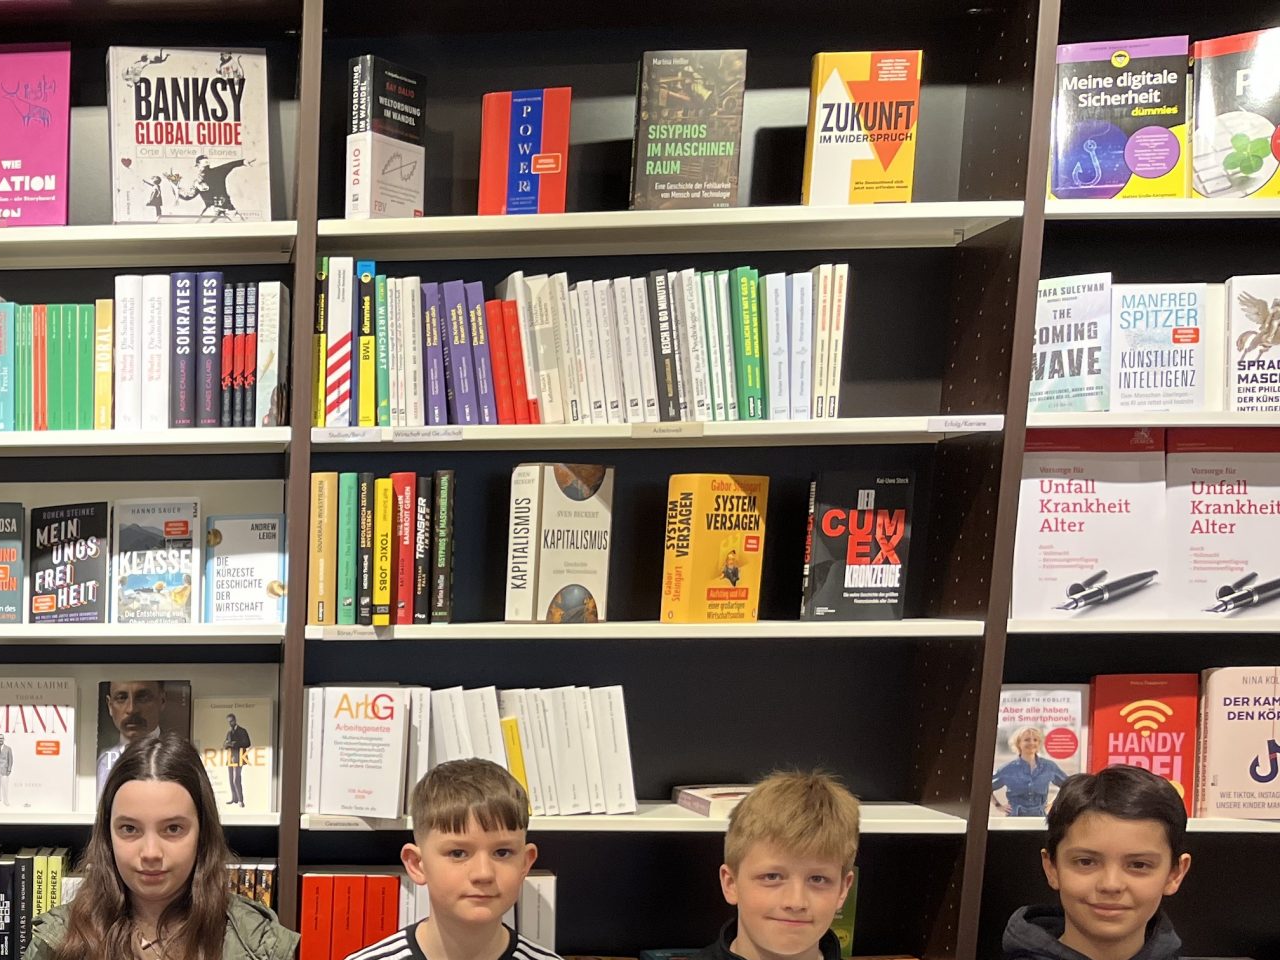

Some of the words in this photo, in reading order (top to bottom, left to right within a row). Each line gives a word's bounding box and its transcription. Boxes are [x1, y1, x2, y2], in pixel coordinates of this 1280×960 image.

[1062, 75, 1113, 90] Meine
[1117, 69, 1177, 89] digitale
[134, 77, 245, 122] BANKSY
[1078, 89, 1160, 108] Sicherheit
[821, 100, 914, 132] ZUKUNFT
[135, 122, 193, 145] GLOBAL
[196, 122, 242, 145] GUIDE
[648, 124, 707, 139] SISYPHOS
[819, 135, 831, 144] IM
[834, 132, 913, 143] WIDERSPRUCH
[140, 148, 159, 156] Orte
[169, 148, 197, 156] Werke
[208, 148, 237, 156] Stories
[647, 143, 662, 157] IM
[665, 141, 734, 157] MASCHINEN
[1, 160, 21, 169] WIE
[646, 160, 681, 175] RAUM
[1122, 293, 1197, 308] MANFRED
[176, 279, 190, 354] SOKRATES
[1053, 309, 1071, 319] THE
[1120, 309, 1198, 329] SPITZER
[378, 306, 387, 369] WIRTSCHAFT
[362, 340, 370, 360] BWL
[1121, 349, 1194, 368] KÜNSTLICHE
[1119, 370, 1196, 389] INTELLIGENZ
[1040, 479, 1096, 494] Unfall
[714, 495, 756, 512] SYSTEM
[1039, 498, 1131, 513] Krankheit
[666, 500, 678, 550] SYSTEM
[675, 492, 693, 557] VERSAGEN
[706, 513, 760, 531] VERSAGEN
[822, 509, 906, 537] CUM
[1039, 518, 1085, 533] Alter
[510, 498, 531, 590] KAPITALISMUS
[543, 529, 608, 550] KAPITALISMUS
[847, 535, 902, 565] EX
[119, 550, 191, 575] KLASSE
[216, 557, 229, 566] DIE
[216, 566, 254, 577] KÜRZESTE
[844, 565, 901, 588] KRONZEUGE
[216, 579, 262, 589] GESCHICHTE
[216, 591, 230, 600] DER
[216, 602, 264, 612] WIRTSCHAFT
[335, 693, 394, 720] ArbG
[1223, 697, 1250, 706] DER
[1227, 711, 1254, 721] DEN
[1108, 732, 1185, 753] HANDY
[204, 748, 266, 767] RILKE
